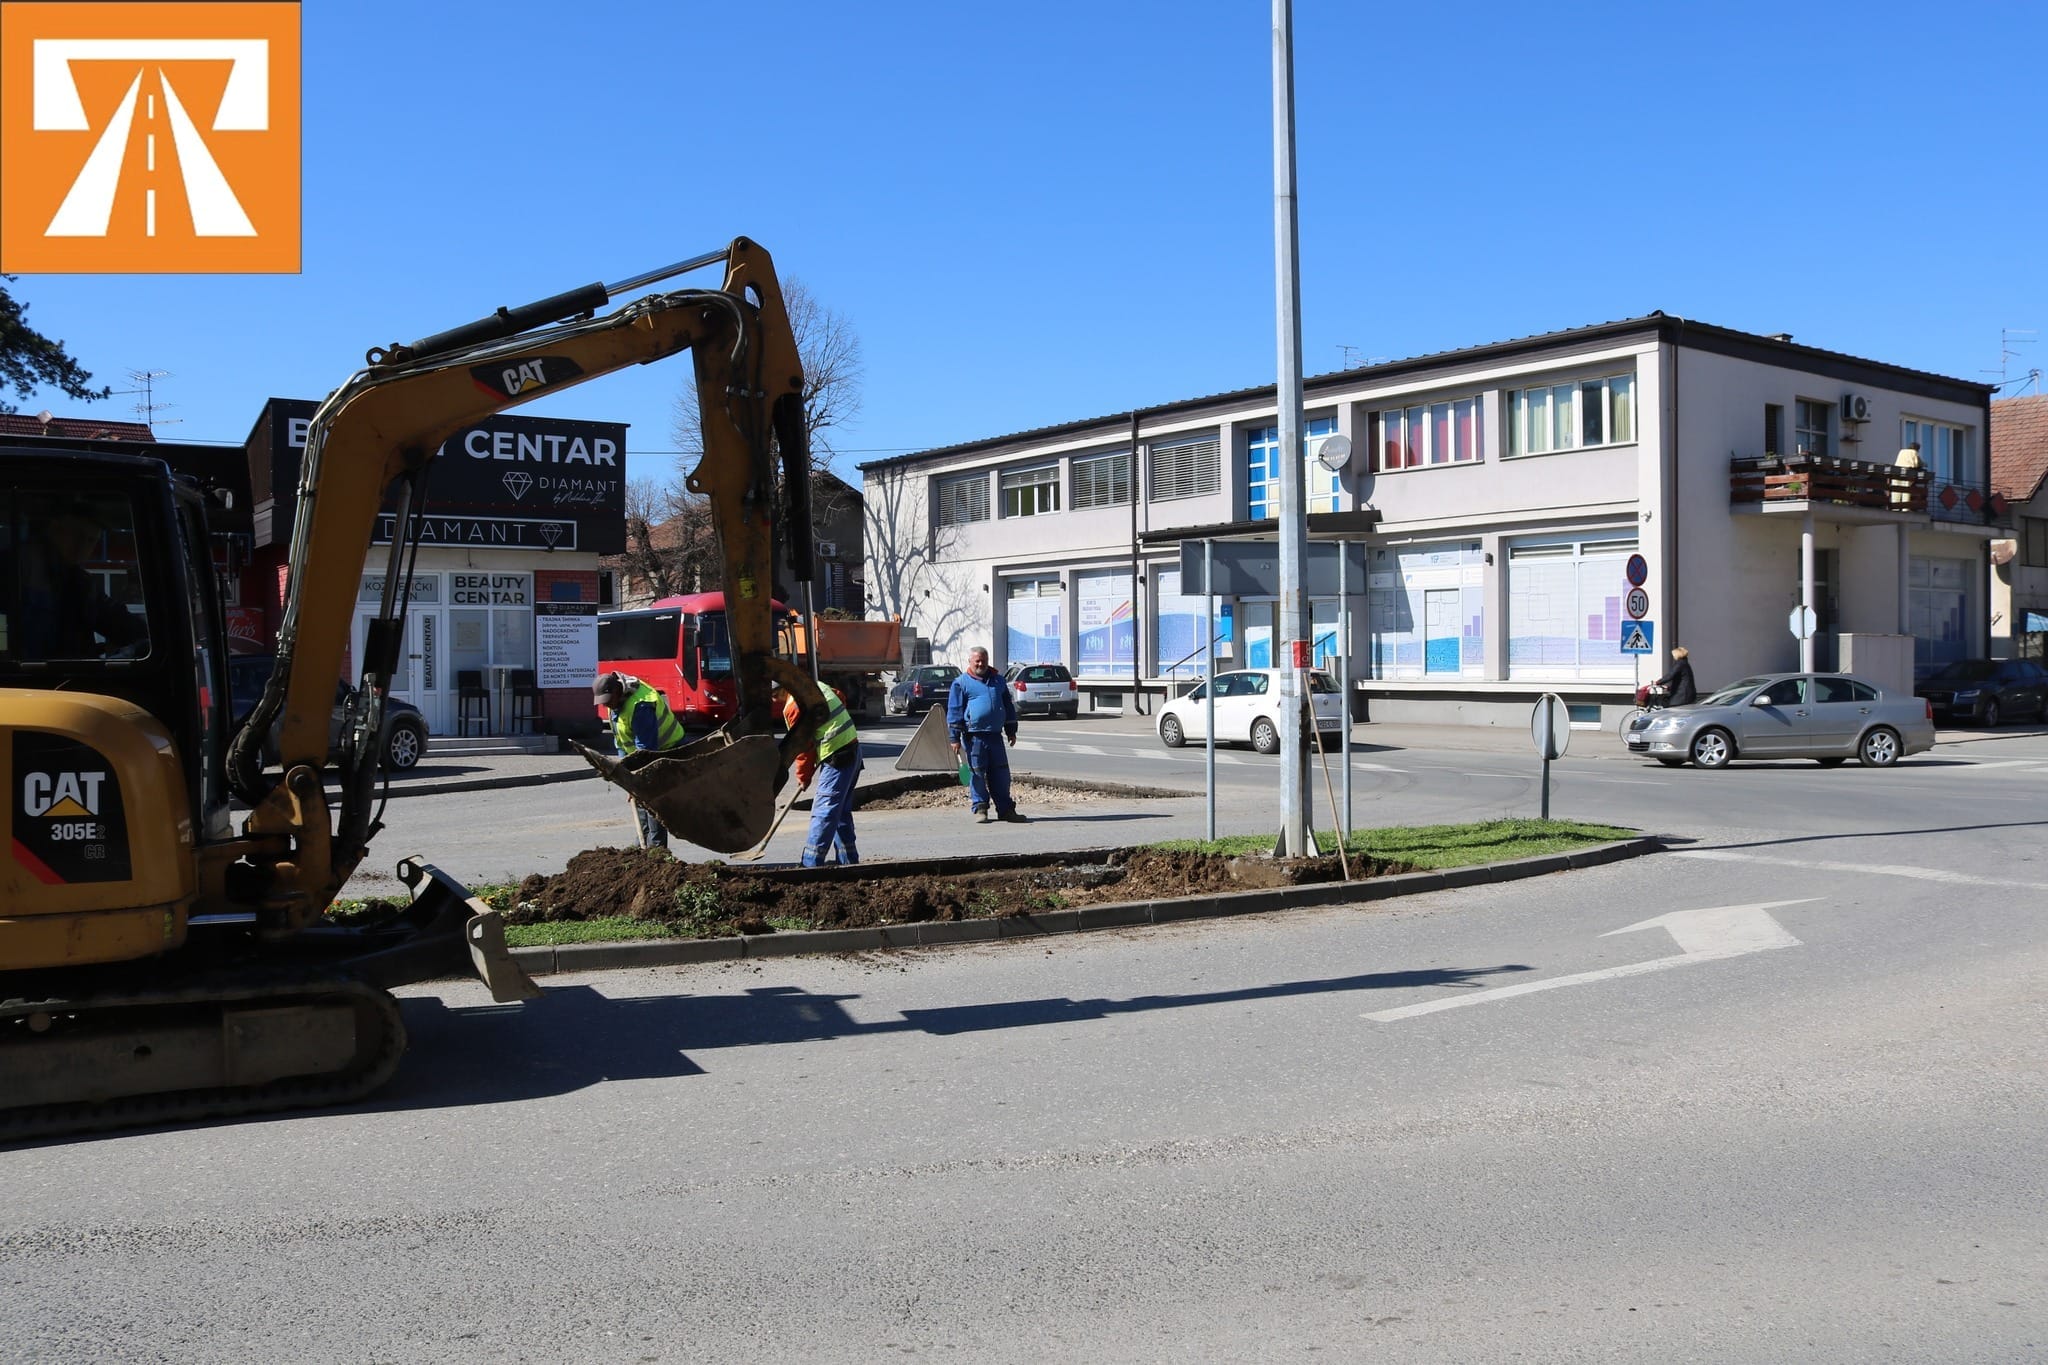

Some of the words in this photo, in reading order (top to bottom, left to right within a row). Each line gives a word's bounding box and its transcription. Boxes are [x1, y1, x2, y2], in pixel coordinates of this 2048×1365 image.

[502, 359, 547, 395] CAT
[464, 430, 617, 467] CENTAR
[539, 477, 617, 492] DIAMANT
[384, 519, 527, 543] DIAMANT
[365, 581, 433, 592] KOZEIČKI
[455, 576, 525, 589] BEAUTY
[455, 591, 525, 604] CENTAR
[1631, 595, 1645, 612] 50
[226, 617, 257, 638] laris
[24, 771, 106, 817] CAT
[51, 822, 106, 841] 305E2
[84, 844, 106, 859] CR
